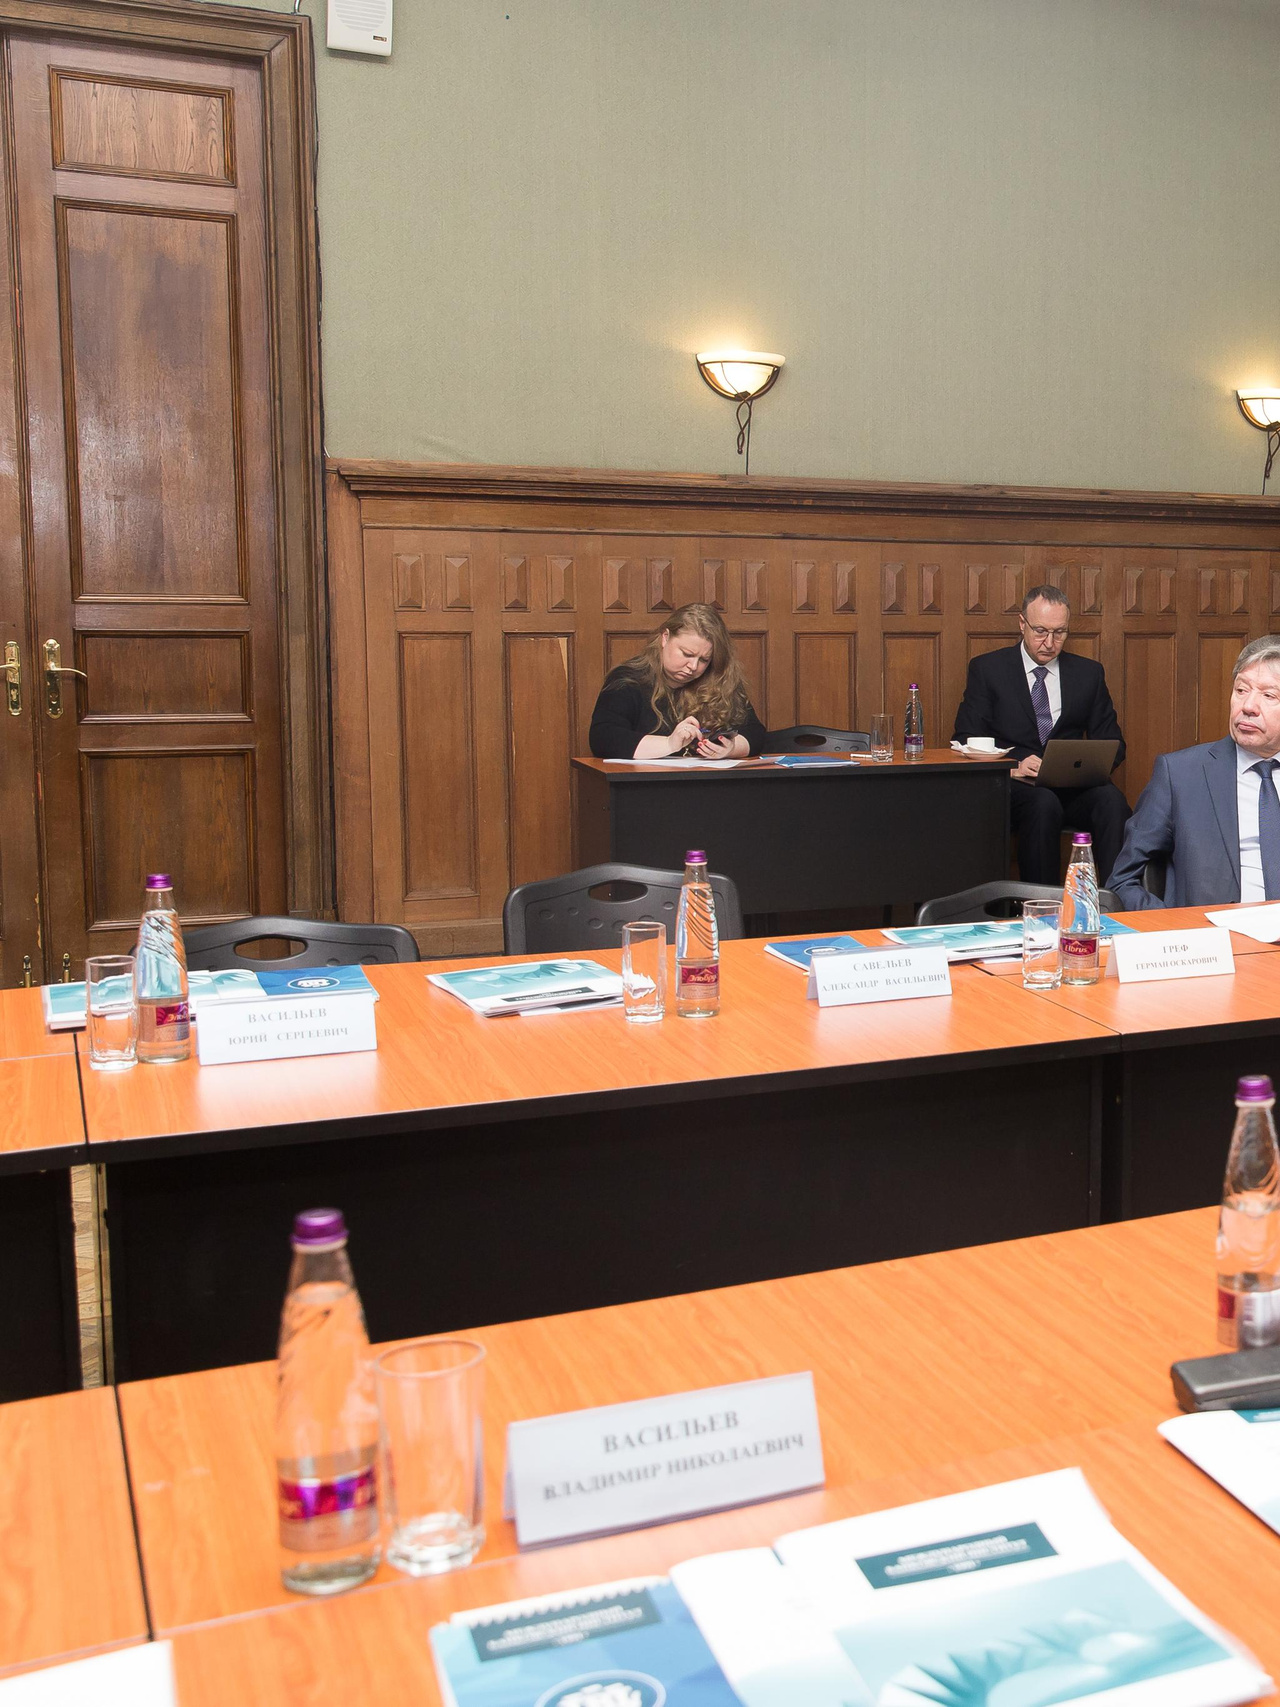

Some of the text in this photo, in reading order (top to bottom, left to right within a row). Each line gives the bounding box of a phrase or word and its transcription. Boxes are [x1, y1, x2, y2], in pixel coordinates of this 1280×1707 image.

[1064, 944, 1088, 953] Elbrus
[1163, 944, 1189, 954] ГРЕФ
[853, 958, 912, 972] САВЕЛЬЕВ
[1136, 956, 1218, 970] ГЕРМАН ОСКАРОВИЧ
[821, 974, 947, 993] АЛЕКСАНДР ВАСИЛЬЕВИЧ
[248, 1008, 328, 1024] ВАСИЛЬЕВ
[229, 1027, 349, 1046] ЮРИЙ СЕРГЕЕВИЧ
[604, 1411, 740, 1454] ВАСИЛЬЕВ
[544, 1434, 805, 1500] ВЛАДИМИР НИКОЛАЕВИЧ
